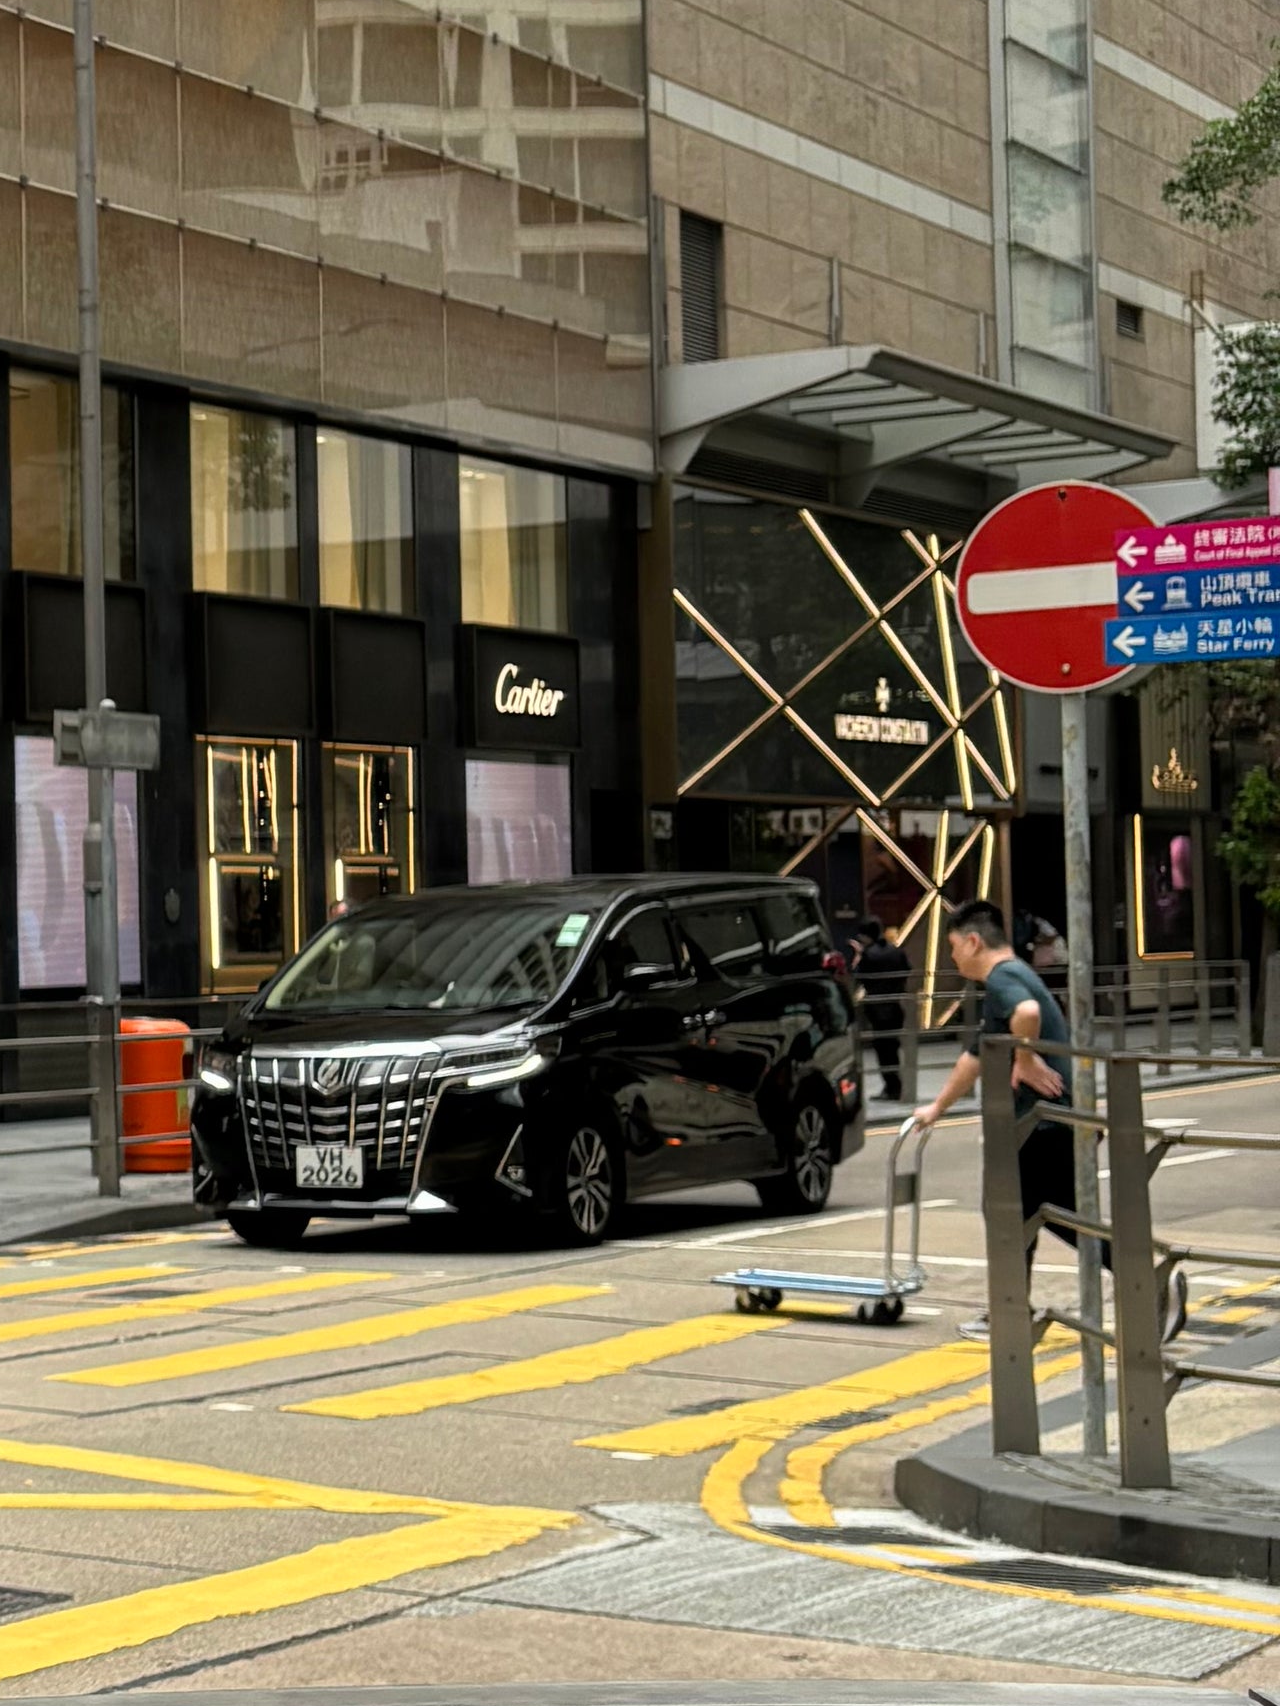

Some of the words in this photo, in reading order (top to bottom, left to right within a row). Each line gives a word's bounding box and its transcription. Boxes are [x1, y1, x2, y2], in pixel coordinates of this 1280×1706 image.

[1201, 589, 1242, 608] Peak
[1197, 639, 1229, 653] Star
[1233, 636, 1275, 653] Ferry
[495, 663, 564, 717] Cartier
[316, 1146, 343, 1166] VH
[302, 1165, 358, 1184] 2026
